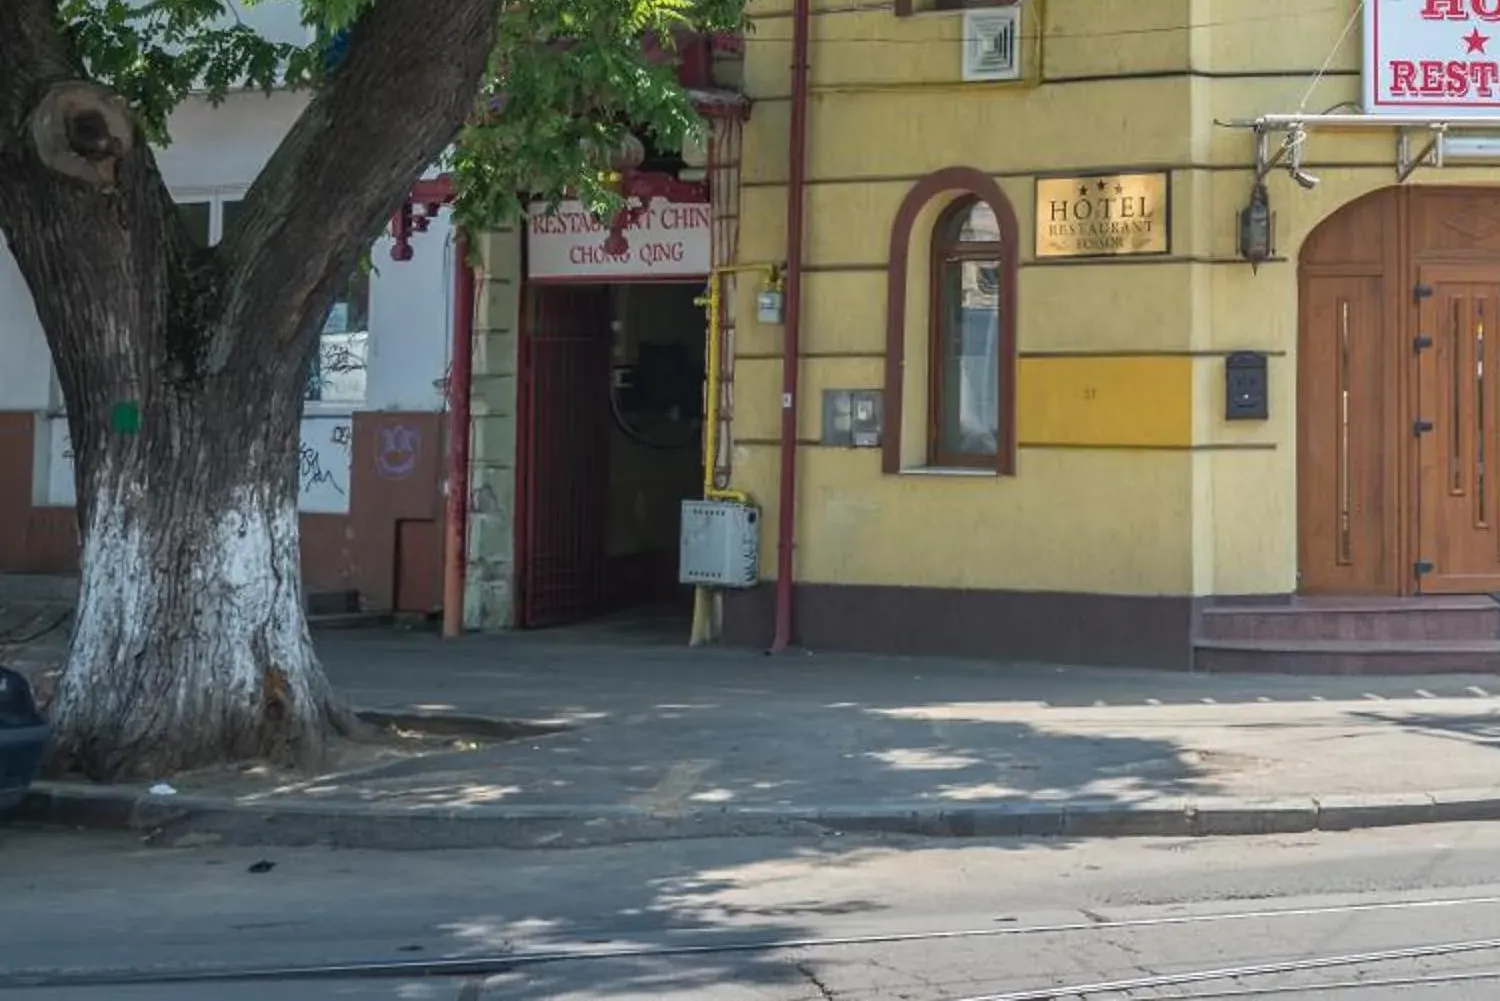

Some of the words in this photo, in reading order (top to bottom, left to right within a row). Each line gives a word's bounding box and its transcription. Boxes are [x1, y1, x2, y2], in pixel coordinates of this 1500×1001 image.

[1050, 196, 1154, 221] HOTEL
[1049, 220, 1152, 236] RESTAURANT
[639, 242, 684, 267] QING
